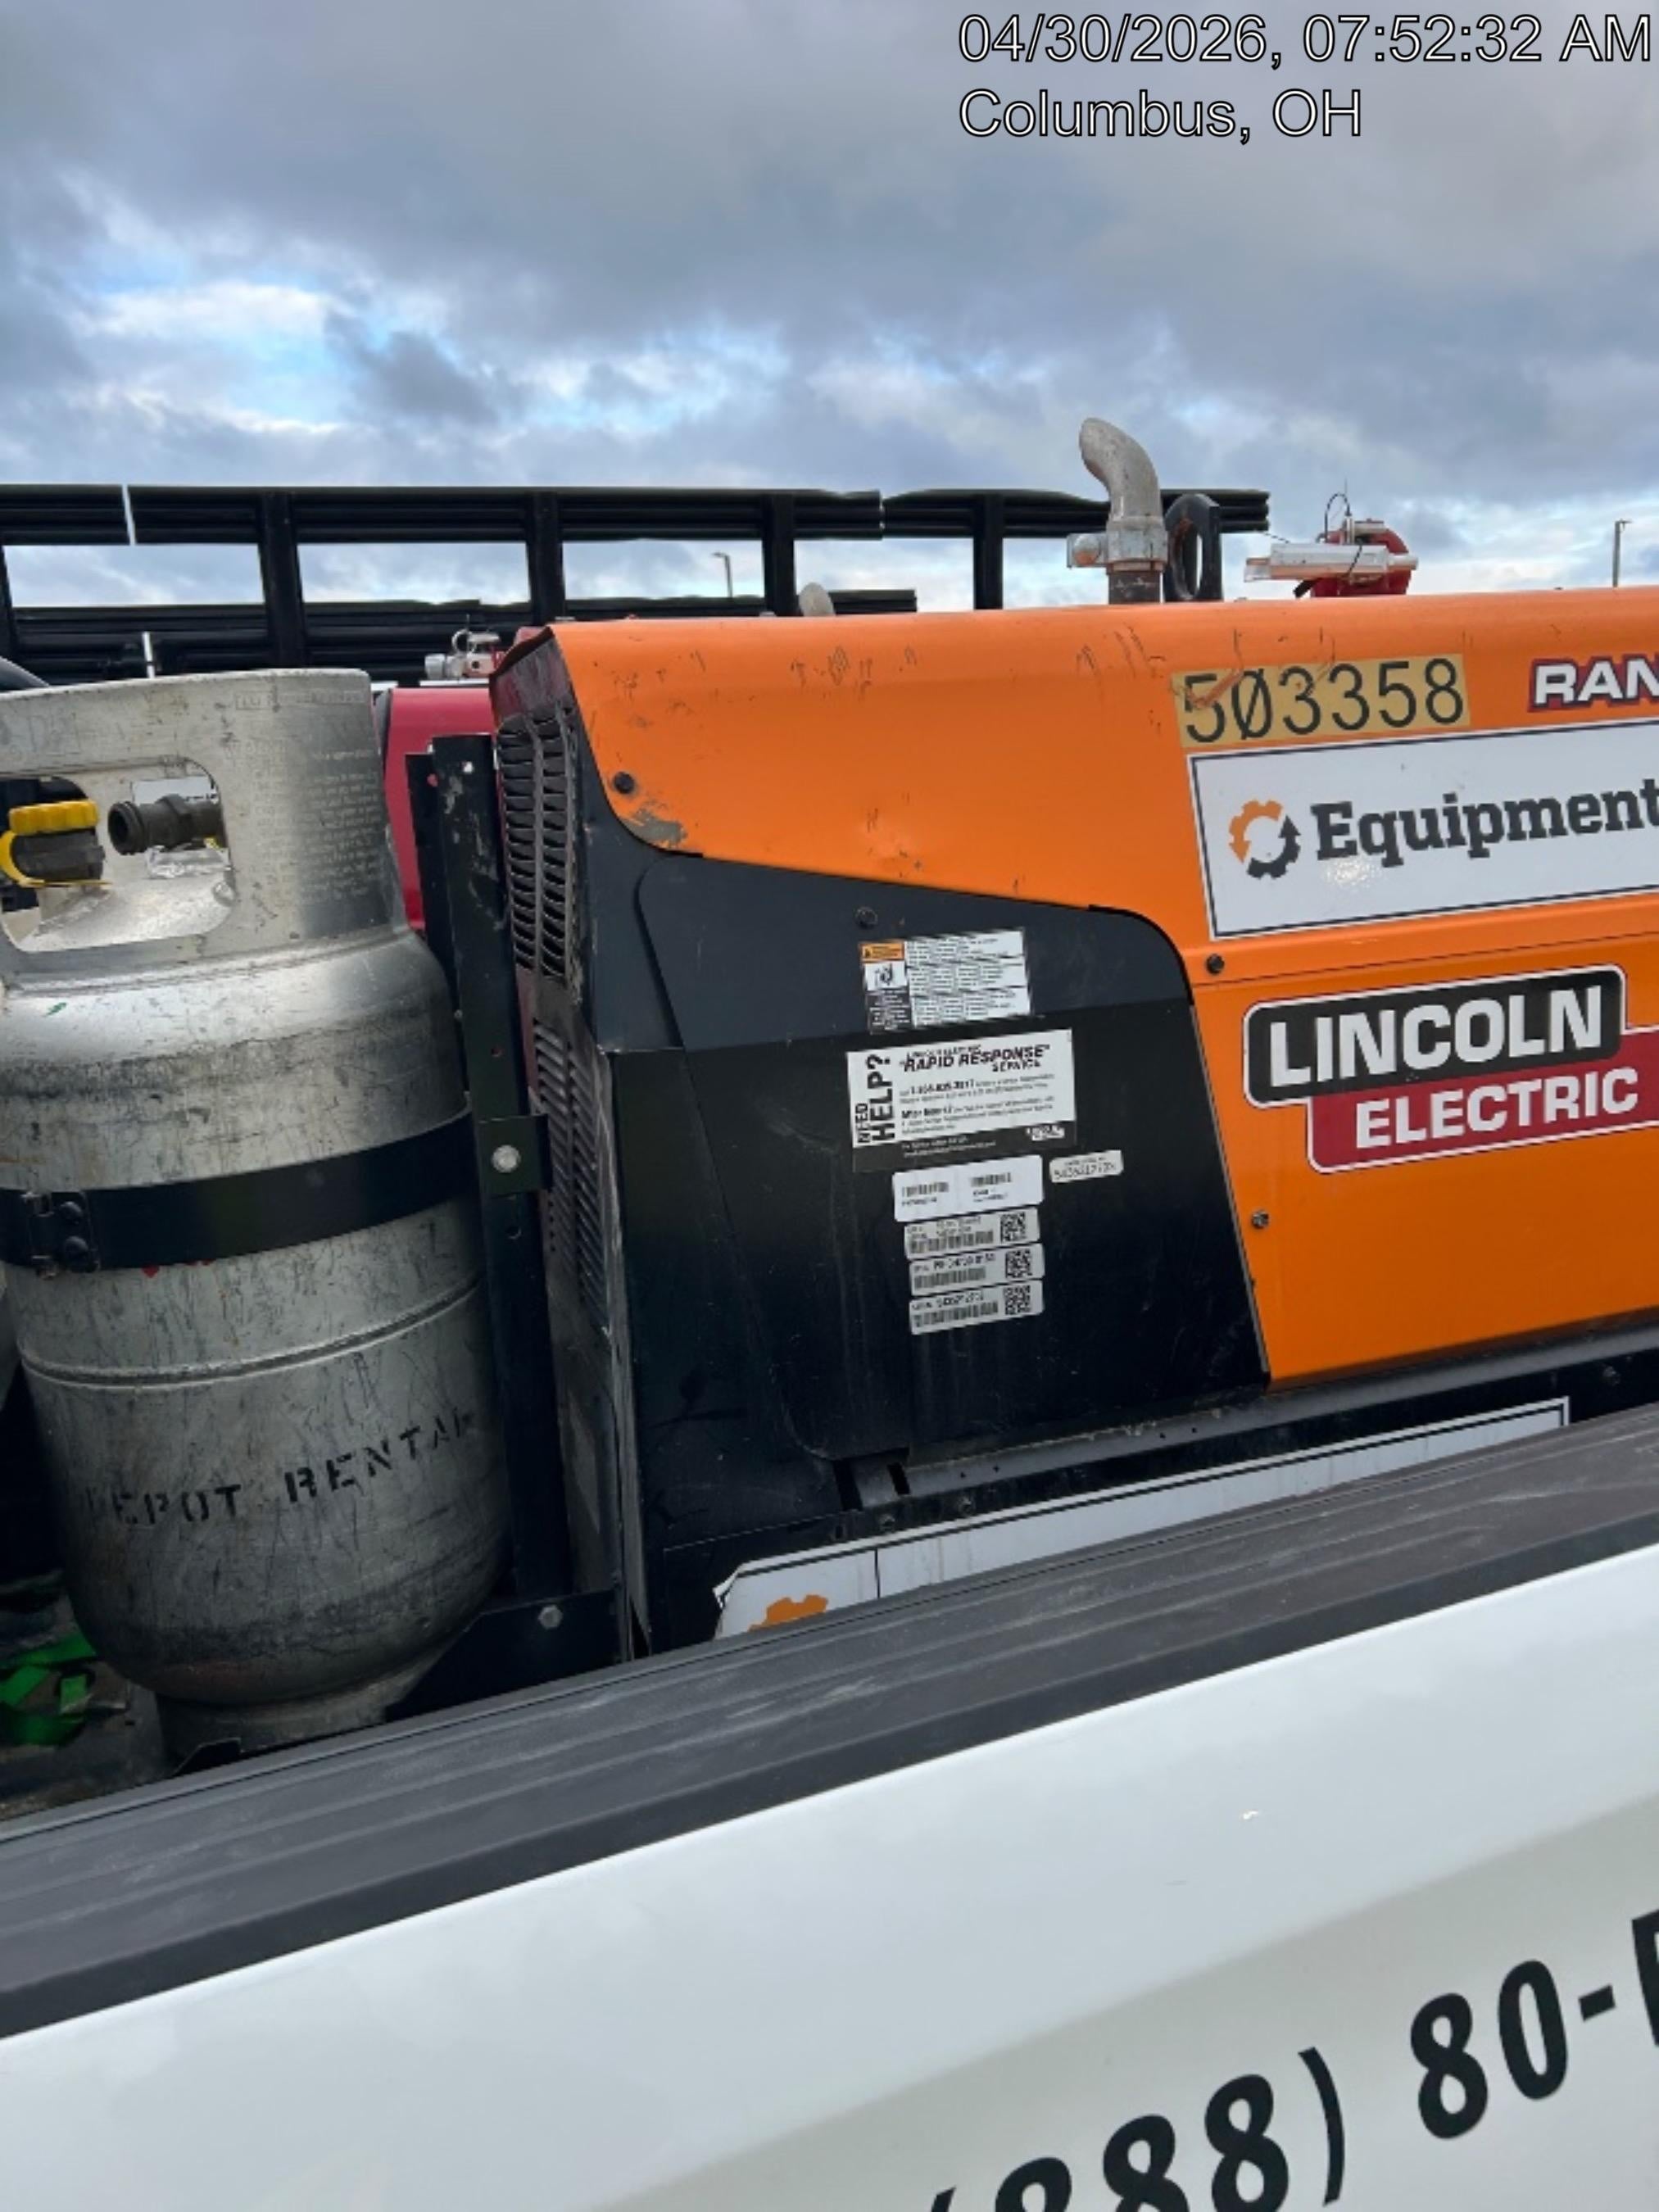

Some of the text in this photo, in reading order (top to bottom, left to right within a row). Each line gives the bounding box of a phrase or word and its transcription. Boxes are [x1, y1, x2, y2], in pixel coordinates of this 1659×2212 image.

[1311, 778, 1659, 867] Equipment
[1270, 986, 1602, 1087] LINCOLN
[865, 1054, 895, 1142] HELP?
[1356, 1067, 1639, 1149] ELECTRIC
